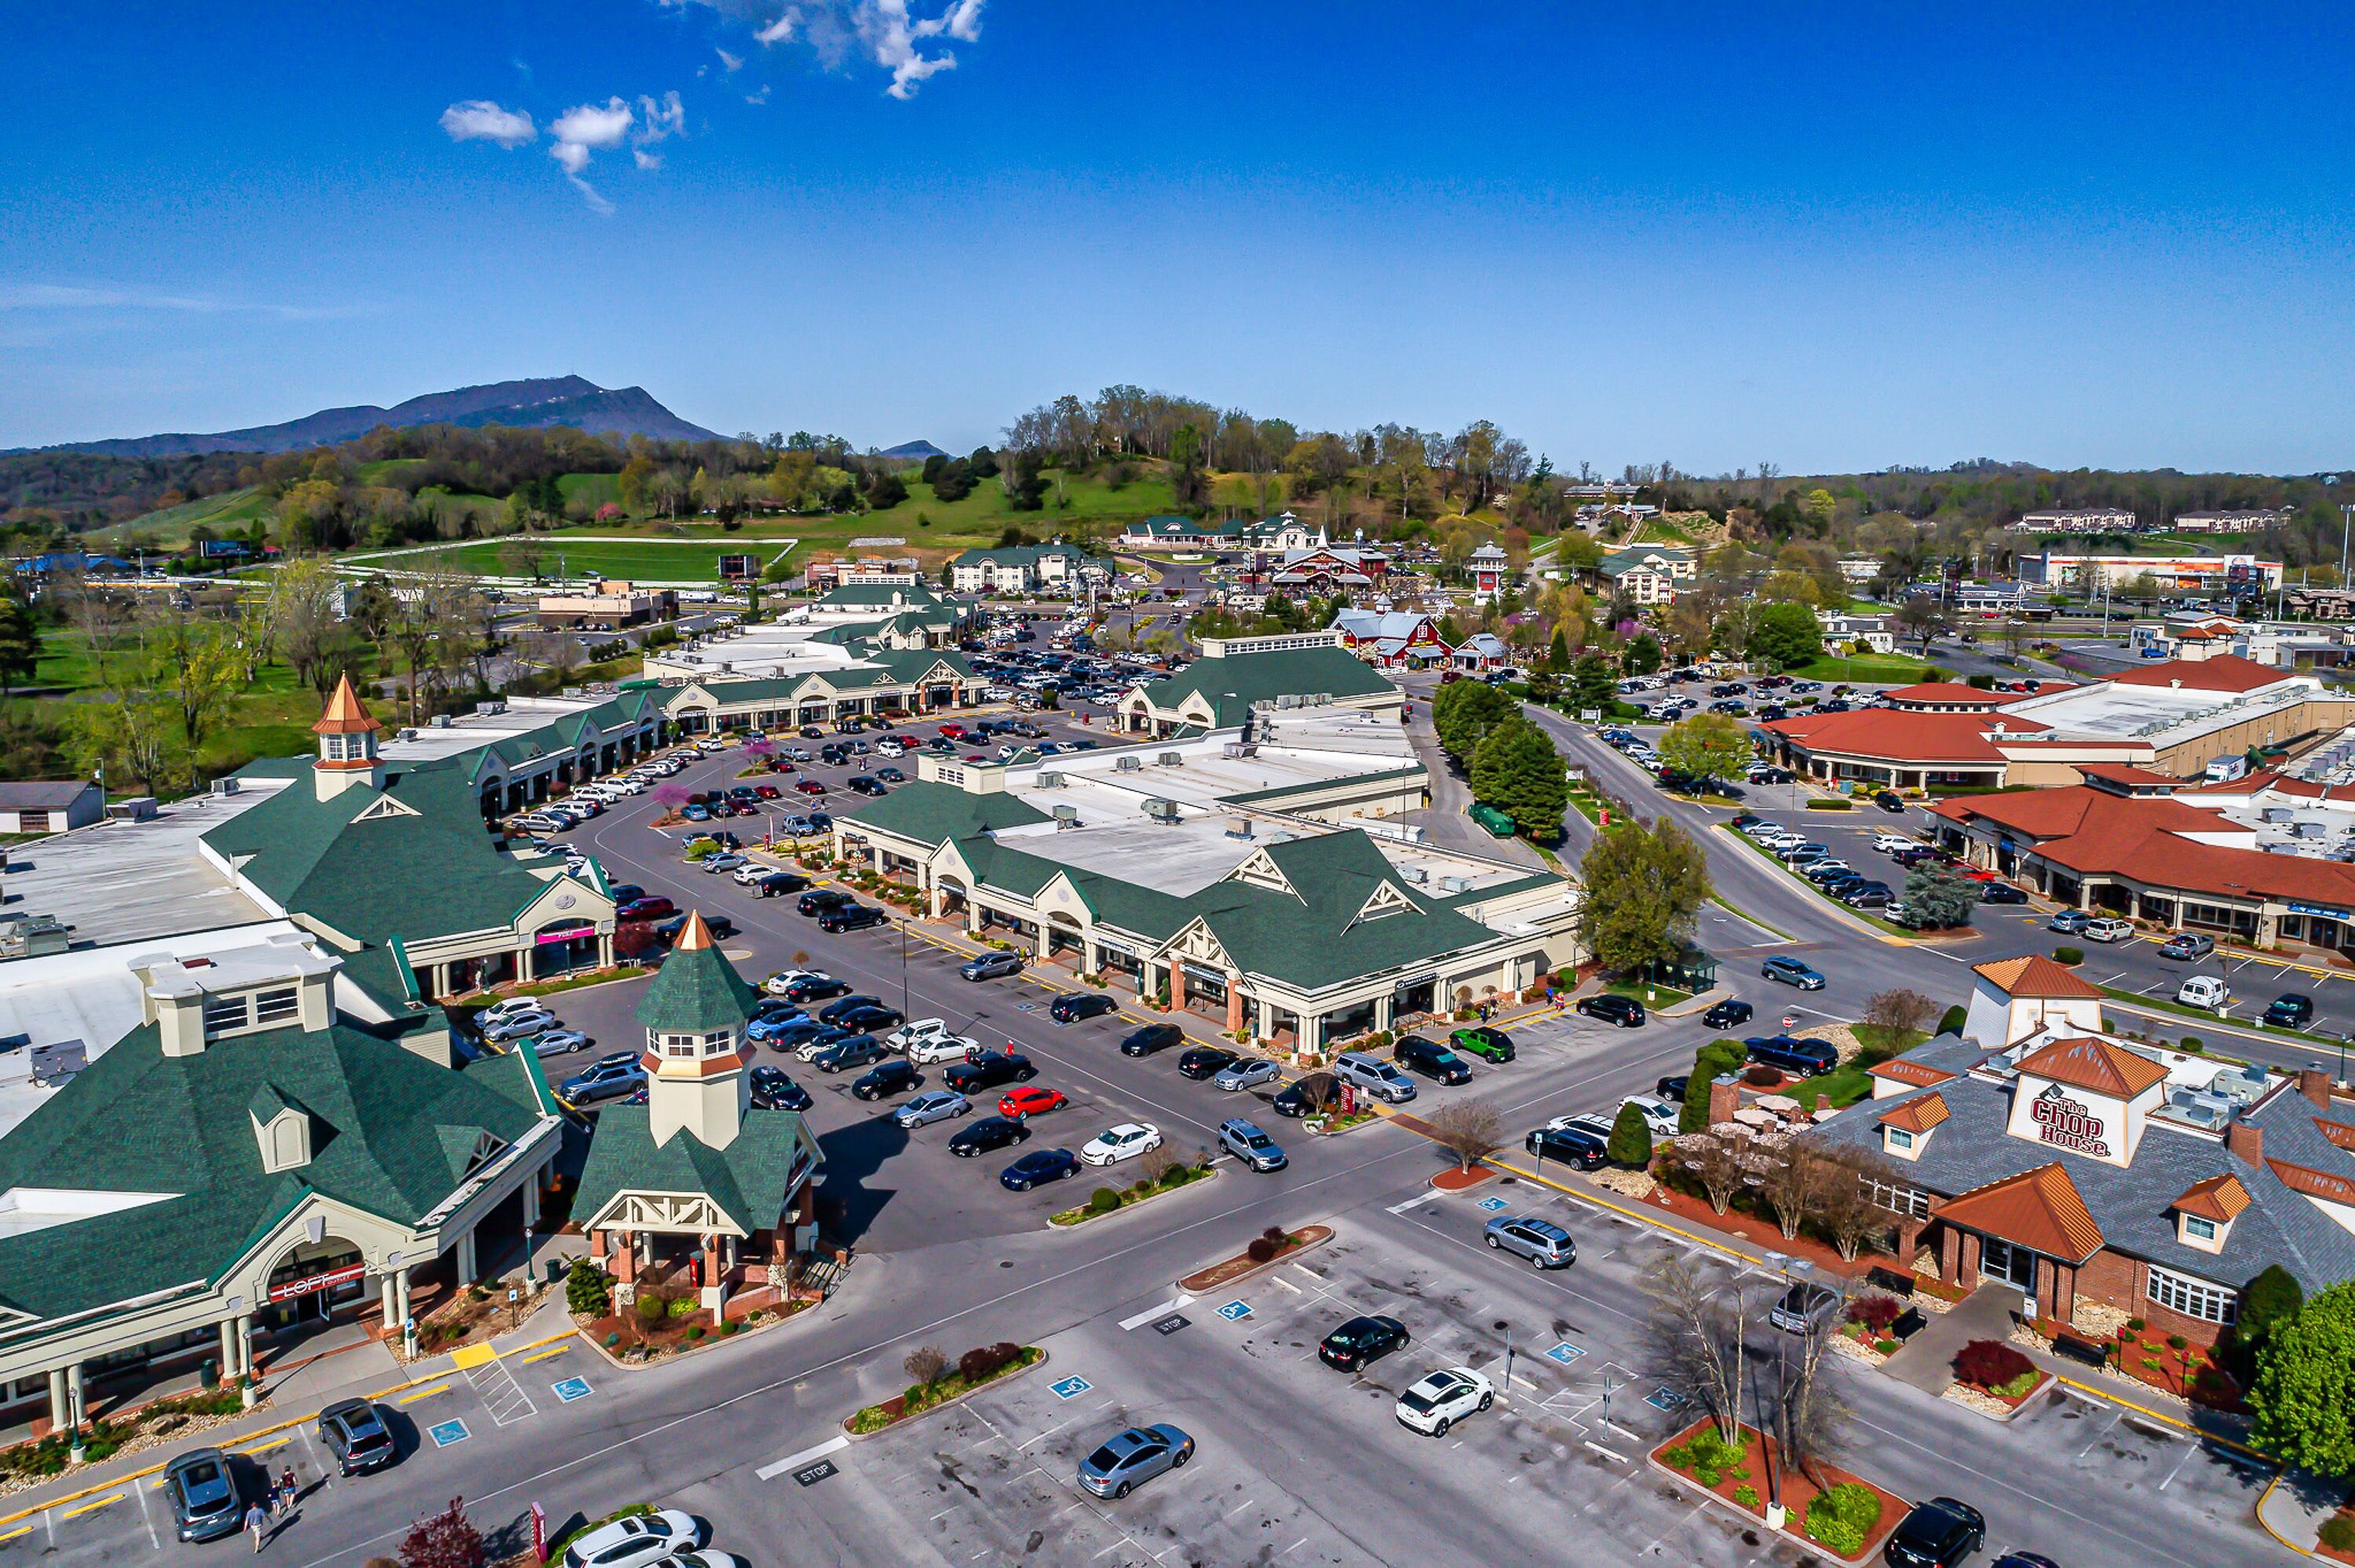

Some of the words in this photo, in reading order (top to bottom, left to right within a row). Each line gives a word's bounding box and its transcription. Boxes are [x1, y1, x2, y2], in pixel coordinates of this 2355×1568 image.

[2031, 1098, 2103, 1138] Chop
[2058, 1099, 2087, 1115] The
[2039, 1123, 2108, 1156] House
[283, 1274, 329, 1296] LOFT
[327, 1274, 350, 1285] OUTLET
[800, 1464, 829, 1482] STOP
